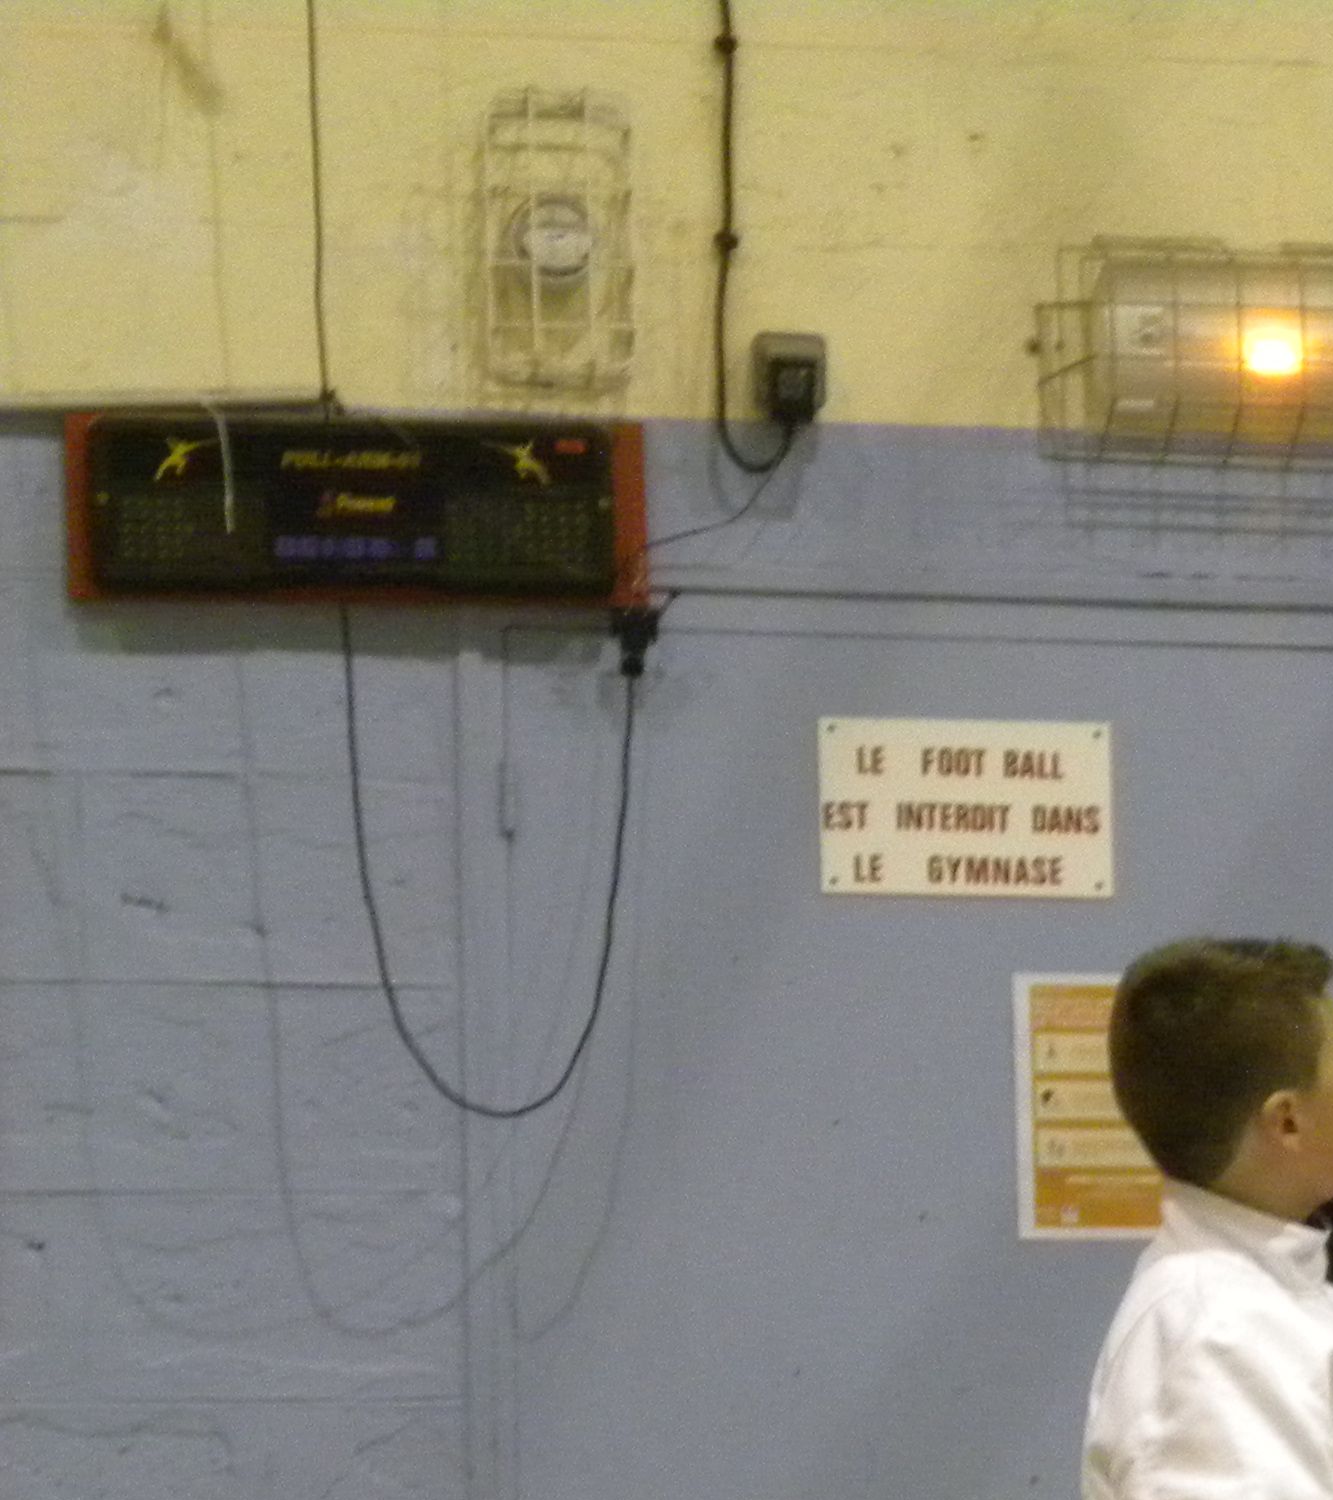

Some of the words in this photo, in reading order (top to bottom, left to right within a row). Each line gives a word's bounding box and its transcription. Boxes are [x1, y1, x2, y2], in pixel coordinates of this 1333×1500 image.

[855, 745, 886, 776] LE
[920, 747, 988, 778] FOOT
[1003, 749, 1064, 780] BALL
[822, 802, 870, 831] EST
[895, 803, 1012, 834] INTERDIT
[1030, 805, 1102, 836] DANS
[854, 854, 885, 884] LE
[927, 855, 1063, 887] GYMNASE
